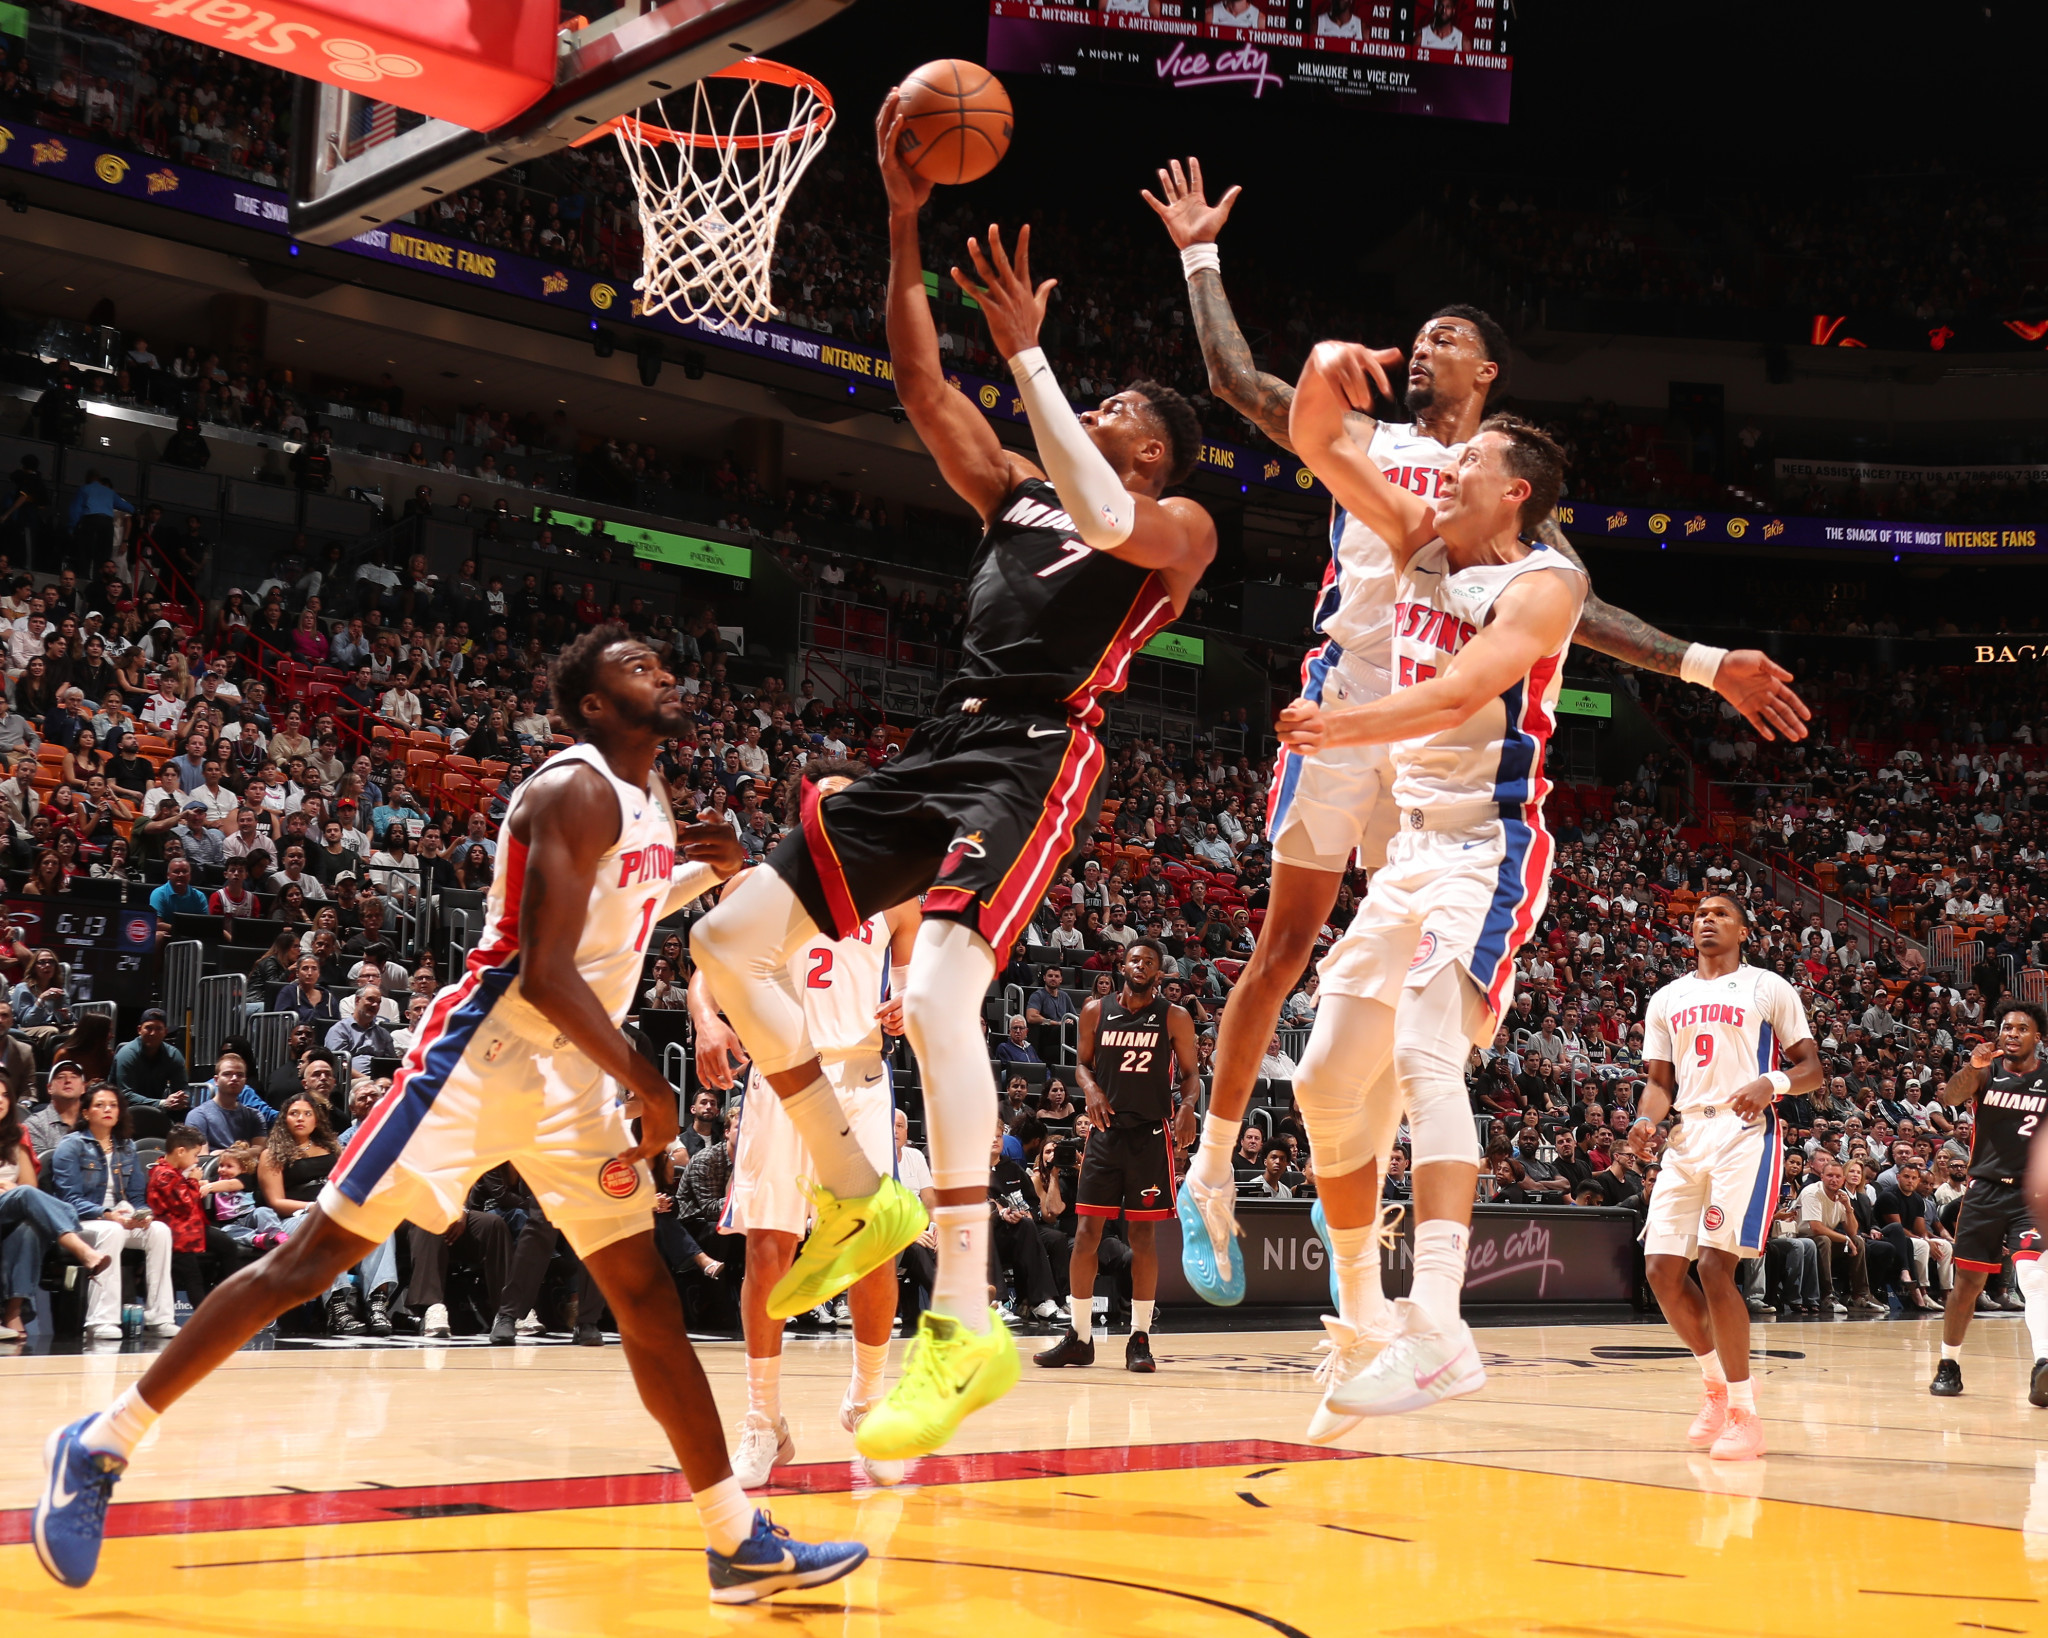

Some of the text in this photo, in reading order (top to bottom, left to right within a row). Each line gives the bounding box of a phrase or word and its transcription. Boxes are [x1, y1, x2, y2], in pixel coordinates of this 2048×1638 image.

[1029, 6, 1039, 18] D.
[1042, 8, 1090, 24] MITCHELL
[1162, 4, 1196, 18] REB 1
[1372, 5, 1406, 20] AST 0
[140, 0, 321, 54] Stat
[1102, 16, 1198, 36] 7 G. ANTETOKOUNMPO
[1267, 16, 1302, 30] REB 0
[1475, 17, 1508, 32] AST 1
[1209, 26, 1302, 48] 11 K. THOMPSON
[1371, 26, 1405, 42] REB 1
[1077, 48, 1140, 63] A NIGHT IN
[1314, 37, 1406, 58] 13 B. ADEBAYO
[1473, 38, 1506, 53] REB 3
[1417, 51, 1507, 70] 22 A. WIGGINS
[1298, 62, 1348, 78] MILWAUKEE
[1367, 70, 1388, 83] VICE
[1390, 72, 1410, 86] CITY
[233, 192, 260, 217] THE
[390, 231, 454, 269] INTENSE
[456, 249, 497, 279] FANS
[754, 330, 770, 347] OF
[770, 333, 790, 352] THE
[791, 338, 820, 360] MOST
[820, 344, 872, 376] INTENSE
[1209, 446, 1235, 470] FANS
[1263, 459, 1281, 480] Takis
[1782, 464, 1812, 476] NEED
[1815, 466, 1891, 480] ASSISTANCE?
[1894, 470, 1922, 482] TEXT
[1926, 472, 1942, 482] US
[1946, 472, 1962, 482] AT
[1606, 512, 1628, 532] Takis
[1684, 516, 1707, 536] Takis
[1762, 521, 1785, 541] Takis
[1825, 527, 2036, 548] THE SNACK OF THE MOST INTENSE FANS
[1033, 537, 1096, 578] 7
[634, 897, 657, 952] 1
[807, 947, 833, 989] 2
[1670, 1003, 1746, 1035] PISTONS
[1101, 1030, 1160, 1048] MIAMI
[1120, 1050, 1152, 1073] 22
[1694, 1034, 1714, 1068] 9
[1982, 1089, 2048, 1113] MIAMI
